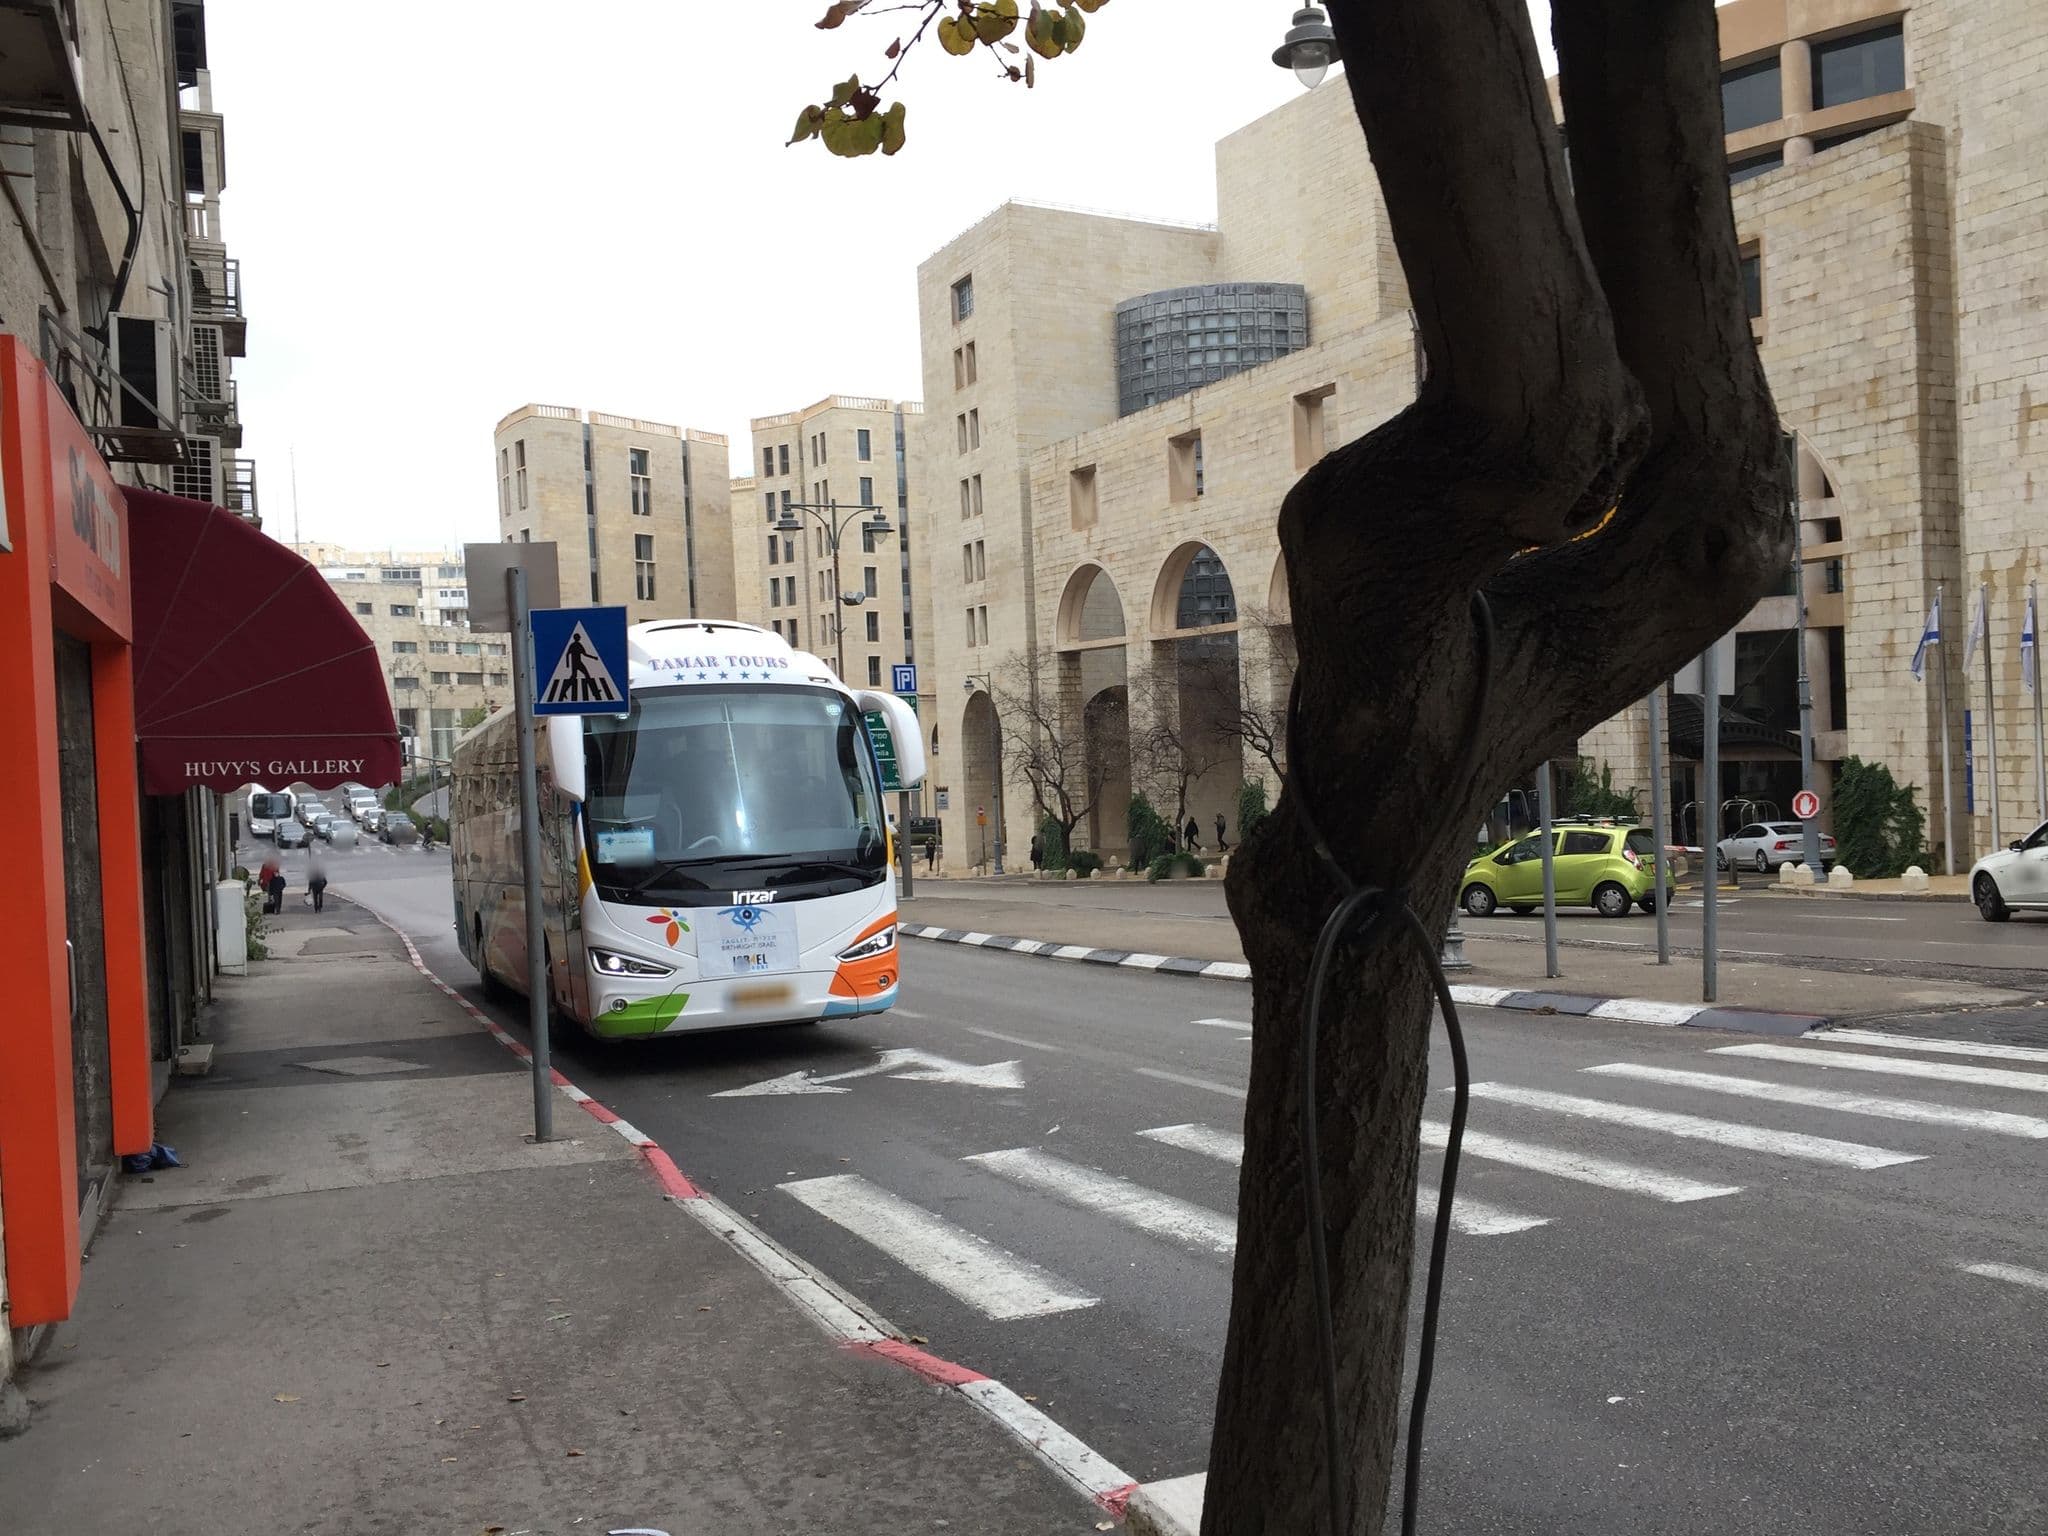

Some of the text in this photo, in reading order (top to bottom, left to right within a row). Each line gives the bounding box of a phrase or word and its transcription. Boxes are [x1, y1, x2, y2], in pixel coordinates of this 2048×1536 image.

[648, 655, 789, 671] TAMAR TOURS
[184, 759, 365, 777] HUVY'S GALLERY
[732, 890, 778, 905] Irizar
